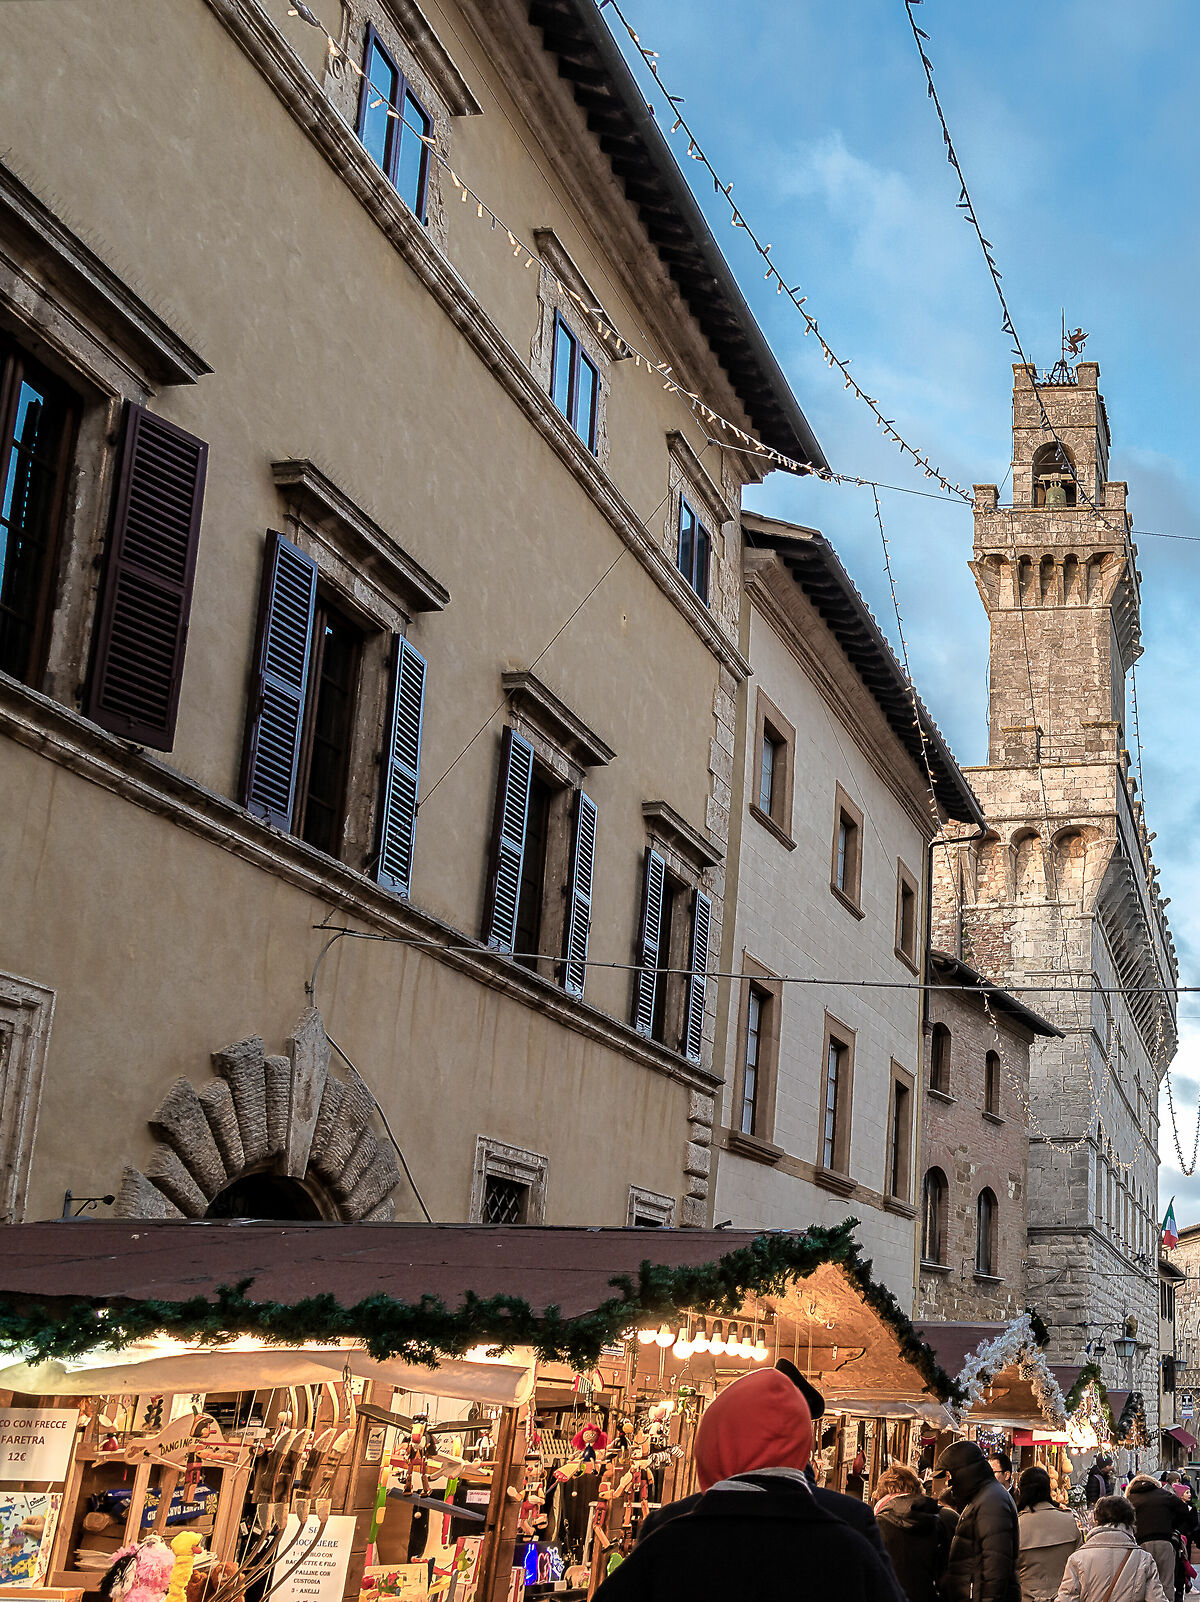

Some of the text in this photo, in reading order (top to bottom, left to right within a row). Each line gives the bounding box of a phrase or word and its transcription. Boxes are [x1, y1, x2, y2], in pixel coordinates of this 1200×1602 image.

[13, 1420, 32, 1428] CON
[34, 1421, 67, 1429] FRECCE
[1, 1436, 45, 1445] FARETRA
[8, 1453, 26, 1461] 12€
